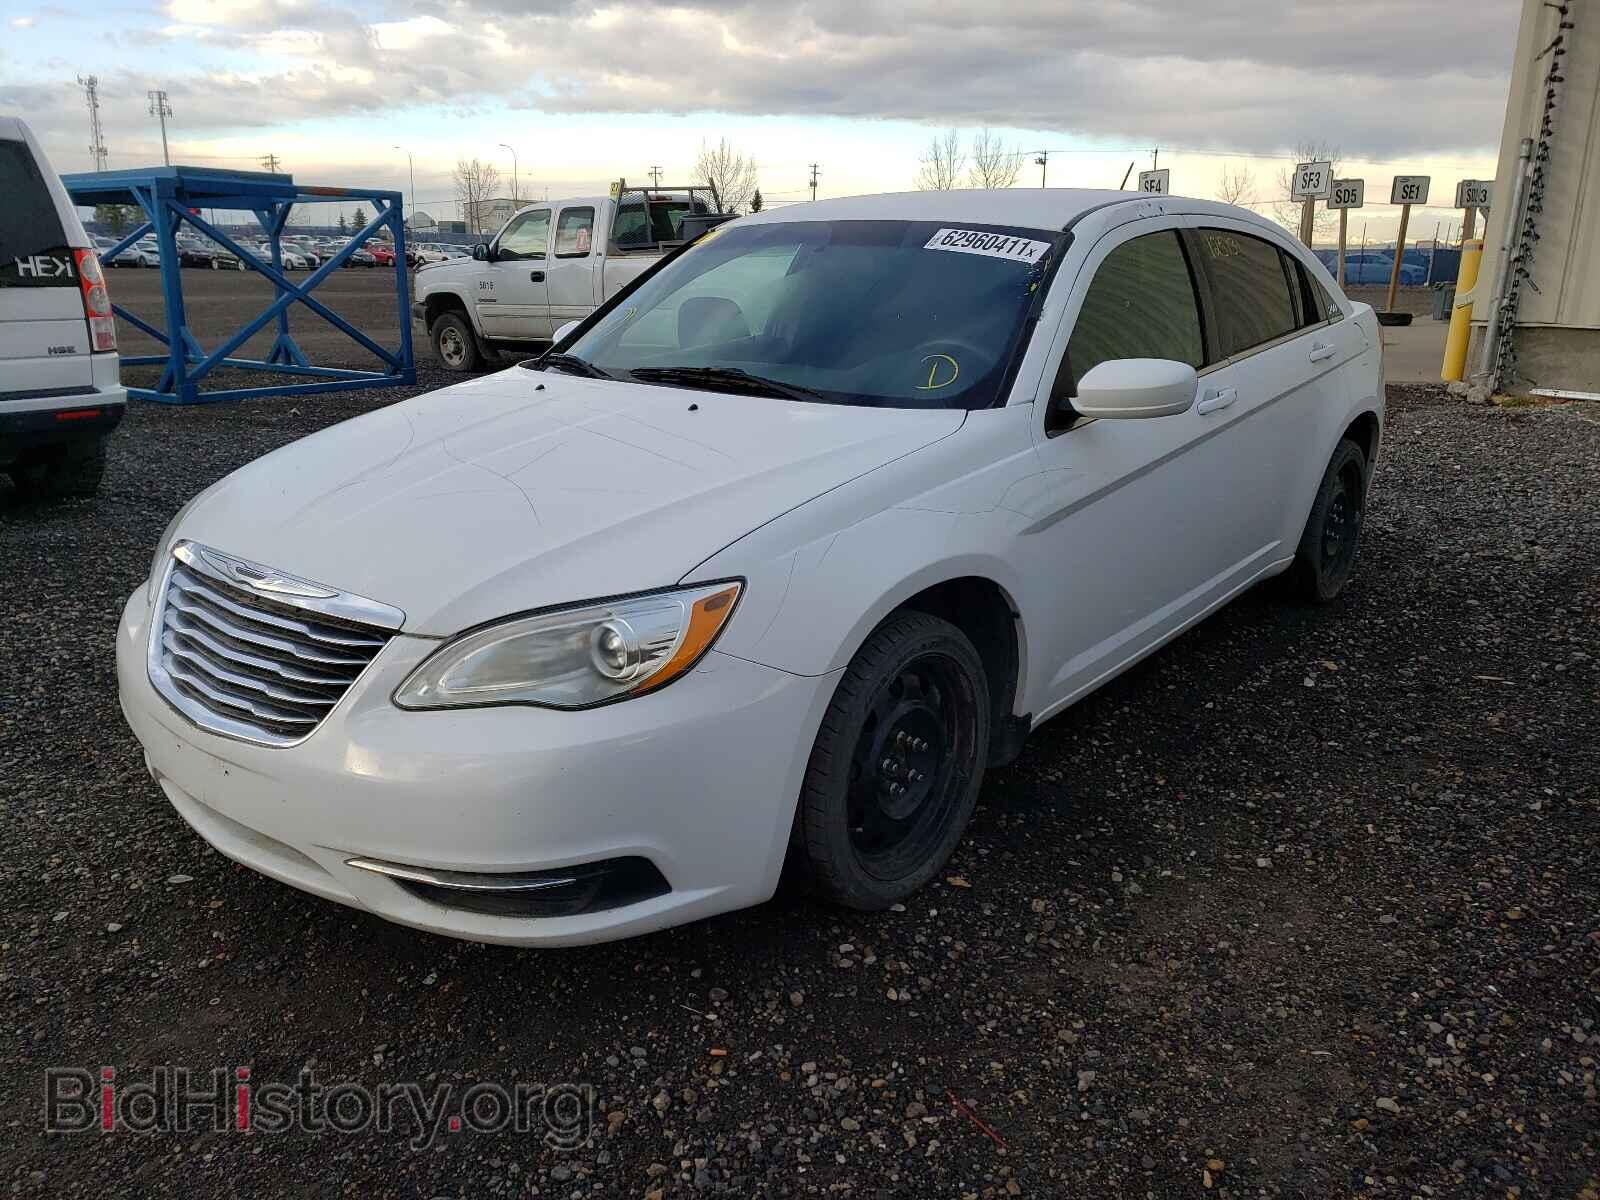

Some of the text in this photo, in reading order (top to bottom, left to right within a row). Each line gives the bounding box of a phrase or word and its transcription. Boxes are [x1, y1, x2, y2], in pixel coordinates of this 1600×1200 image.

[1301, 171, 1321, 189] SF3
[1335, 188, 1357, 204] SD5
[1401, 183, 1421, 200] SE1
[47, 345, 77, 355] HSE
